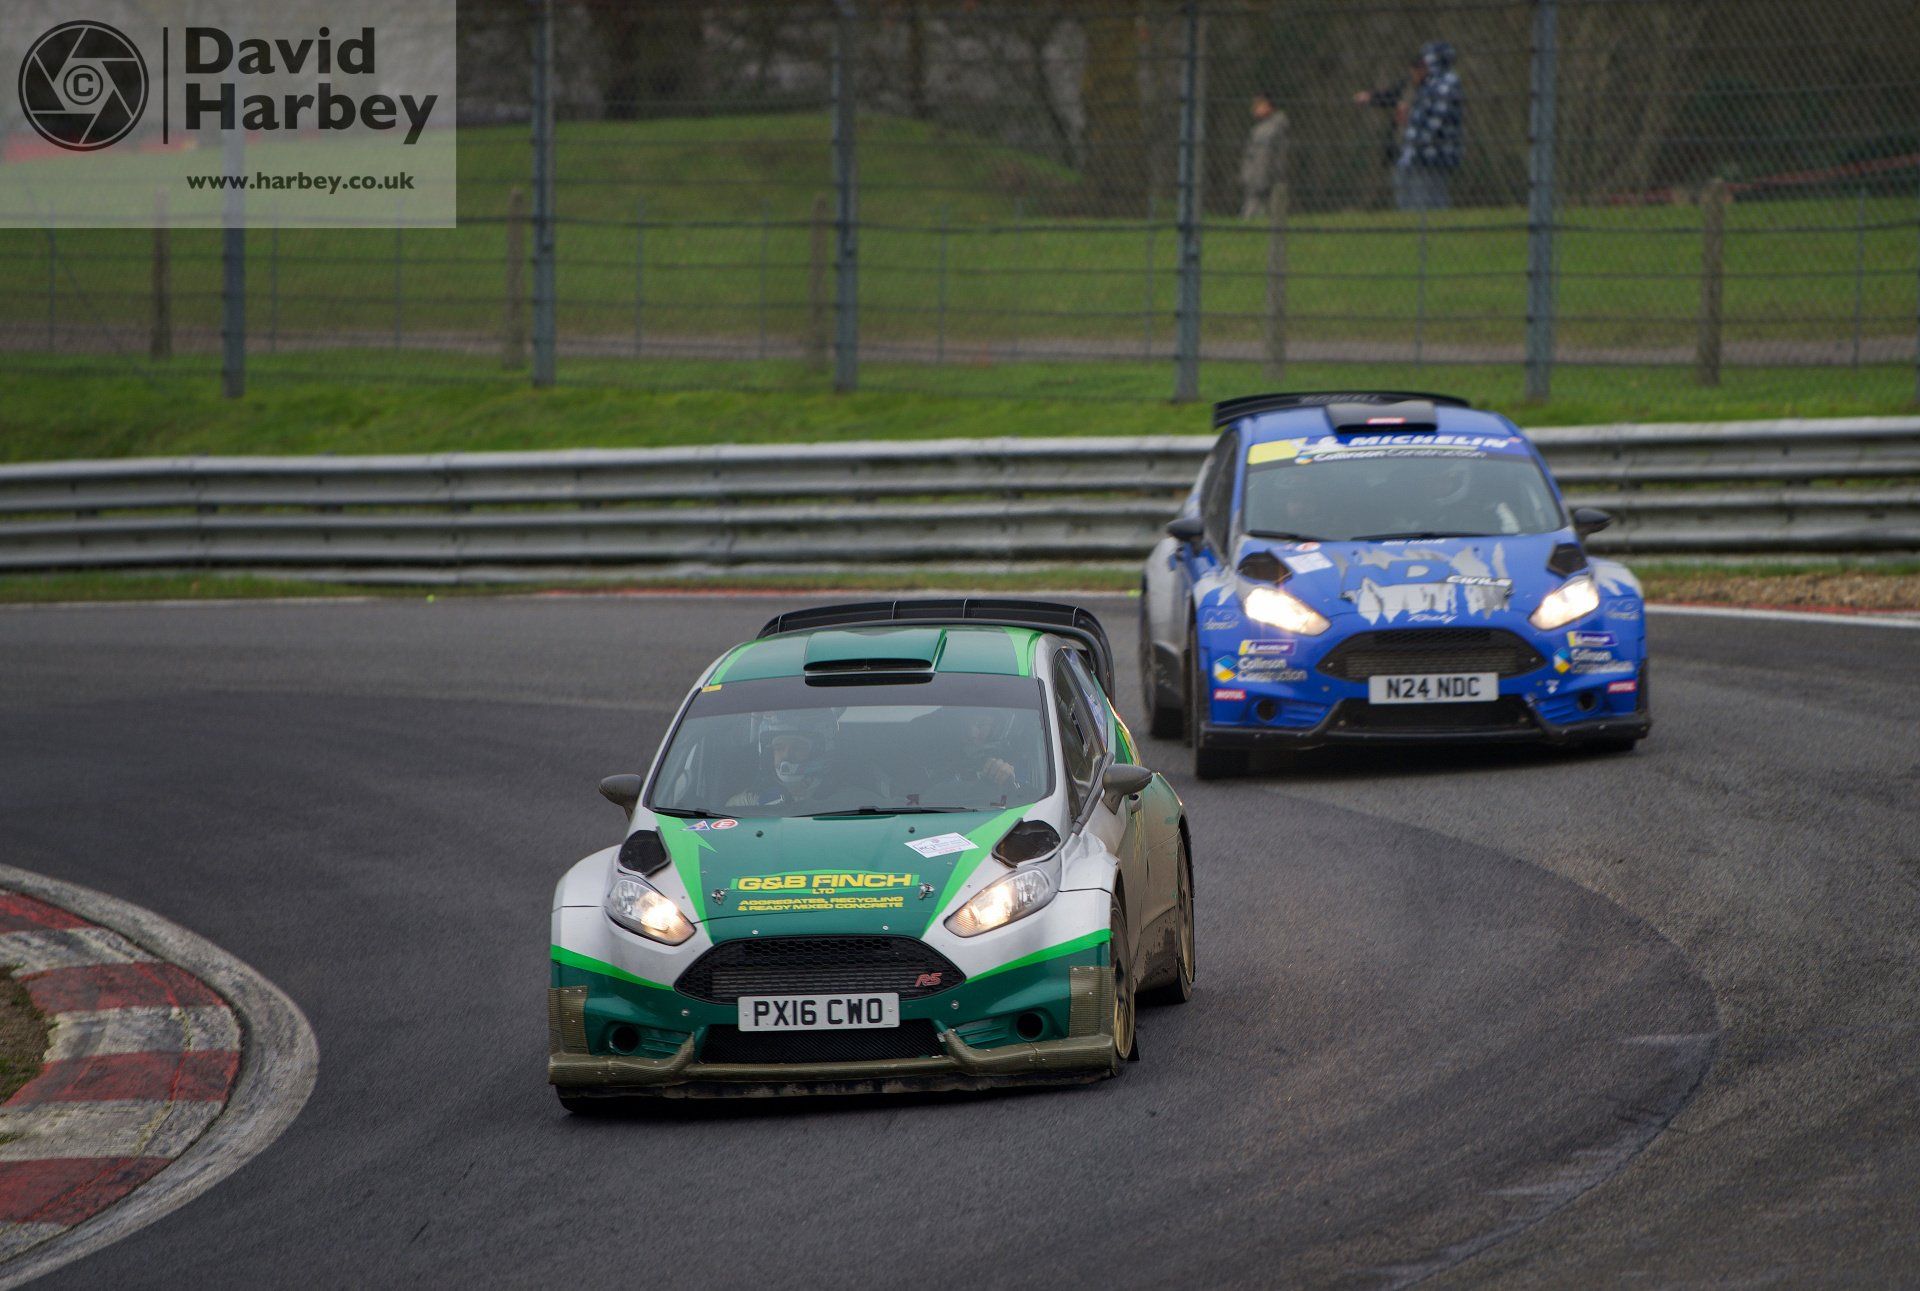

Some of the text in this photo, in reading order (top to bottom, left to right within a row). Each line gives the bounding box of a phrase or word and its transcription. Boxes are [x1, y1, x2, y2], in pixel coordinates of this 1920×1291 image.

[1349, 435, 1509, 448] MICHELIN
[1386, 676, 1480, 698] N24 NDC
[738, 874, 911, 890] G&B FINCH
[740, 898, 827, 906] AGGREGATES,
[915, 972, 942, 987] RS
[753, 998, 883, 1027] PX16 CWO
